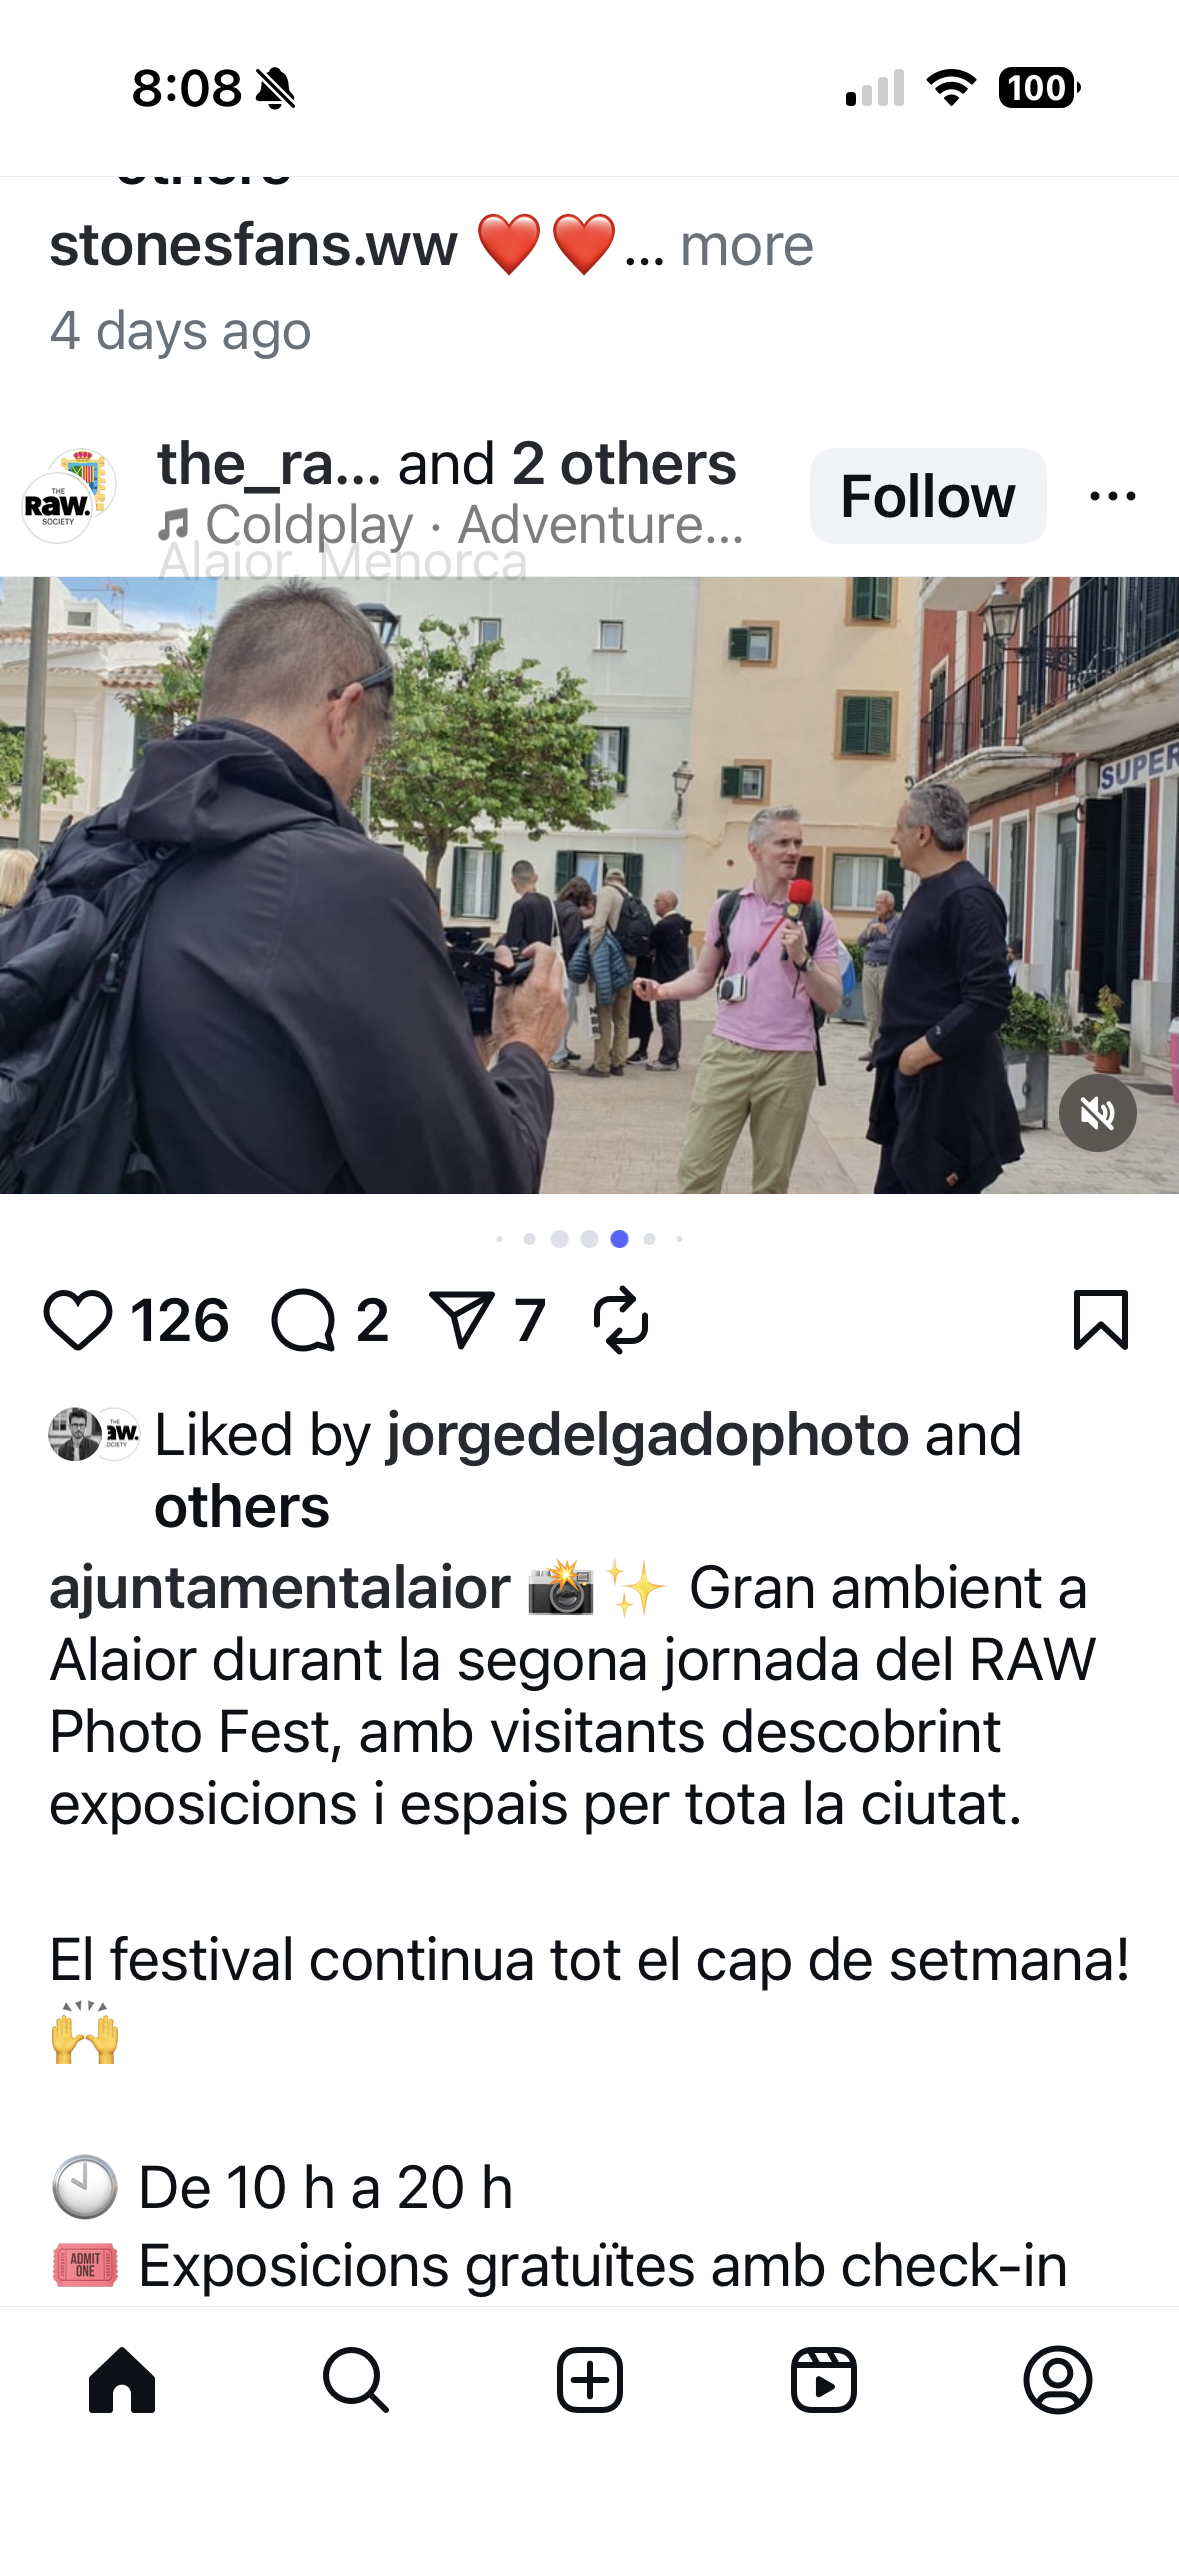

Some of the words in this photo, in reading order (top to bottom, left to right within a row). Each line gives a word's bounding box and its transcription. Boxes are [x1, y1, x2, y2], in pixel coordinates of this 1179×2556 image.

[133, 69, 242, 107] 8:08
[1008, 74, 1066, 101] 100
[50, 220, 458, 266] stonesfans.ww
[683, 233, 813, 266] more
[51, 311, 80, 349] 4
[98, 309, 206, 359] days
[223, 320, 310, 359] ago
[157, 440, 379, 494] the_ra...
[399, 440, 493, 485] and
[513, 440, 544, 484] 2
[561, 440, 736, 485] others
[843, 473, 1016, 518] Follow
[207, 503, 413, 553] Coldplay
[458, 503, 742, 544] Adventure...
[322, 541, 527, 581] Menorca
[1102, 742, 1179, 790] SUPER
[132, 1297, 228, 1342] 126
[357, 1297, 388, 1341] 2
[515, 1298, 545, 1341] 7
[158, 1411, 291, 1456] Liked
[312, 1411, 371, 1466] by
[385, 1409, 909, 1466] jorgedelgadophoto
[926, 1411, 1020, 1456] and
[155, 1483, 329, 1528] others
[50, 1562, 511, 1619] ajuntamentalaior
[691, 1564, 813, 1609] Gran
[832, 1564, 1042, 1609] ambient
[1059, 1576, 1085, 1609] a
[50, 1636, 197, 1681] Alaior
[214, 1636, 382, 1681] durant
[401, 1636, 438, 1681] la
[459, 1648, 645, 1691] segona
[662, 1636, 857, 1691] jornada
[877, 1636, 951, 1681] del
[973, 1637, 1096, 1680] RAW
[53, 1708, 201, 1753] Photo
[222, 1709, 340, 1763] Fest,
[360, 1708, 472, 1753] amb
[491, 1708, 704, 1753] visitants
[723, 1708, 1001, 1753] descobrint
[51, 1780, 356, 1835] exposicions
[375, 1780, 383, 1824] i
[402, 1780, 567, 1835] espais
[586, 1792, 670, 1835] per
[685, 1784, 784, 1825] tota
[805, 1780, 842, 1825] la
[863, 1780, 1024, 1825] ciutat.
[53, 1936, 91, 1980] El
[110, 1936, 291, 1981] festival
[311, 1936, 532, 1981] continua
[550, 1940, 621, 1981] tot
[639, 1936, 678, 1981] el
[698, 1948, 791, 1991] cap
[810, 1936, 872, 1981] de
[891, 1937, 1130, 1981] setmana!
[142, 2165, 210, 2209] De
[228, 2165, 285, 2209] 10
[306, 2164, 333, 2208] h
[352, 2176, 378, 2209] a
[399, 2165, 463, 2209] 20
[484, 2164, 511, 2208] h
[70, 2253, 100, 2264] ADMIT
[76, 2265, 95, 2277] ONE
[142, 2242, 448, 2297] Exposicions
[467, 2242, 694, 2297] gratuïtes
[712, 2242, 824, 2287] amb
[843, 2242, 1067, 2287] check-in
